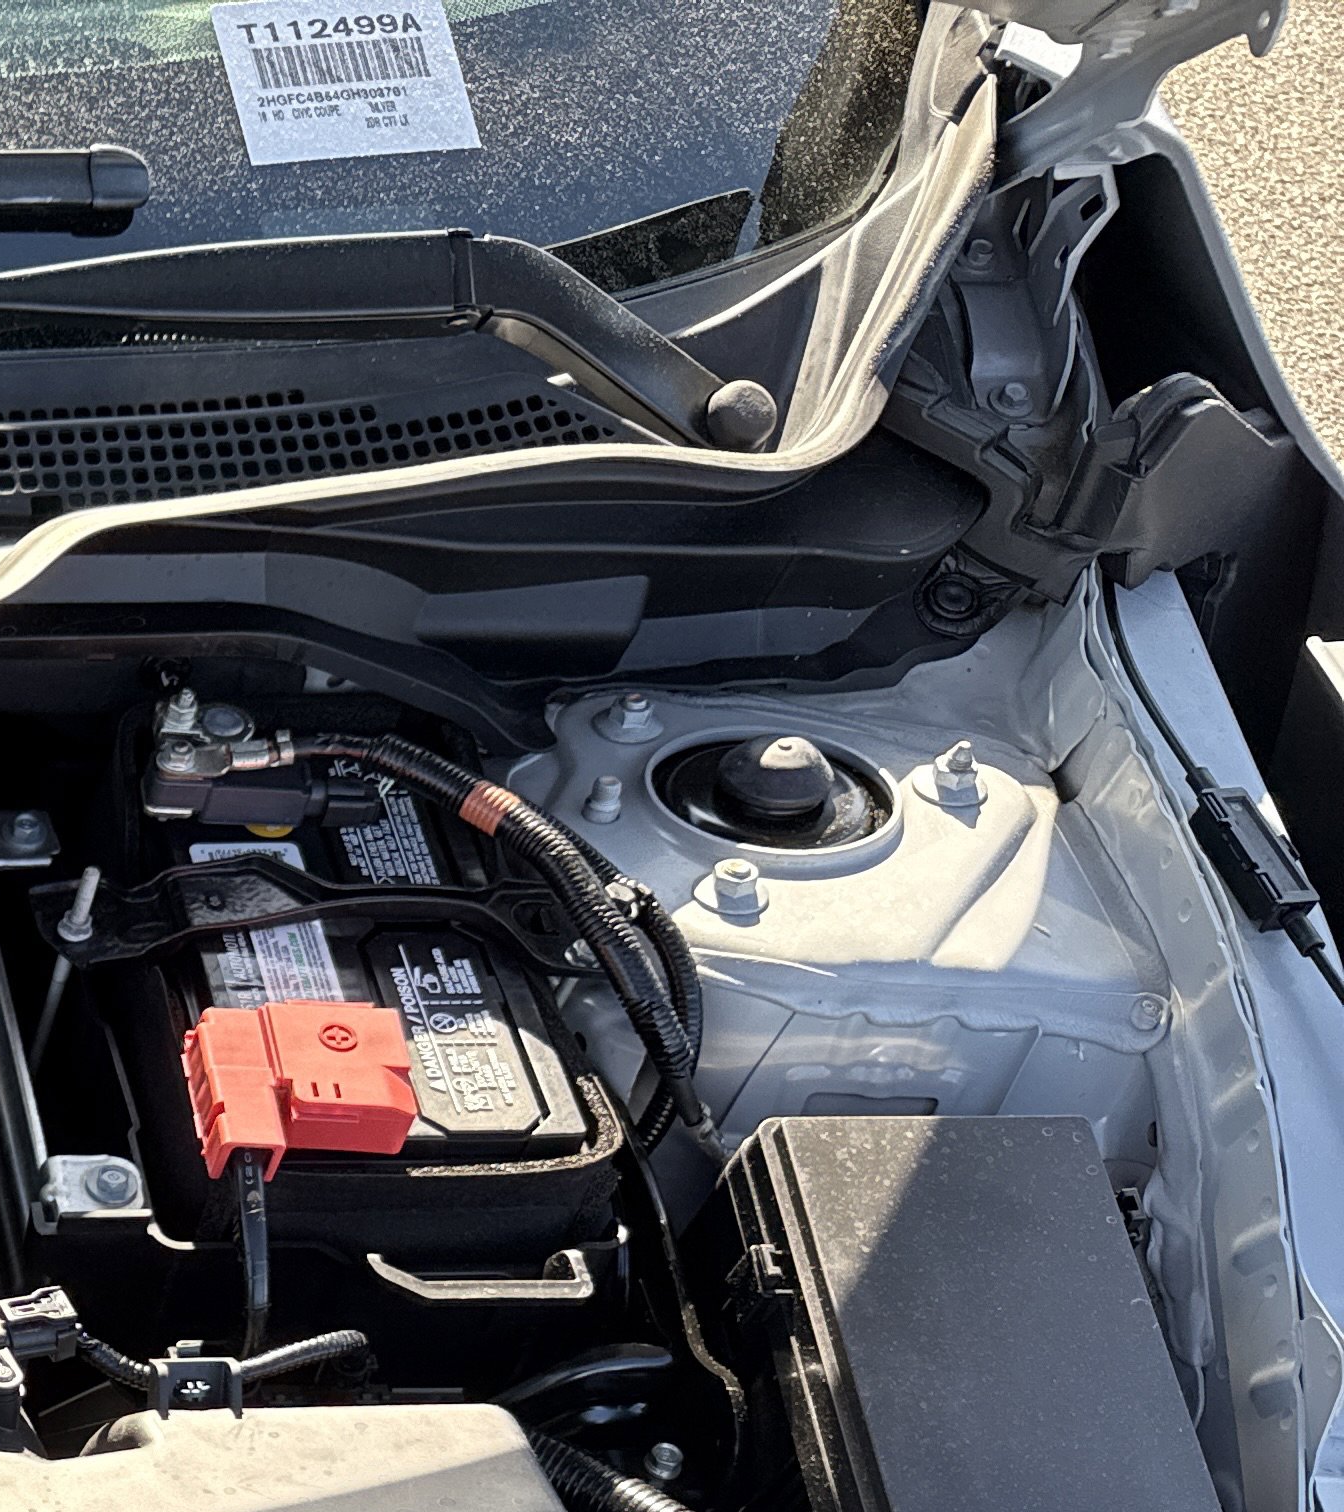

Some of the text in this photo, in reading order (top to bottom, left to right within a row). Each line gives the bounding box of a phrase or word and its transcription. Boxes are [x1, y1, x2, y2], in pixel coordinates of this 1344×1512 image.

[237, 12, 423, 44] T112499A
[314, 105, 342, 118] COUPE
[390, 967, 419, 1014] POISON
[411, 1025, 443, 1078] DANGER
